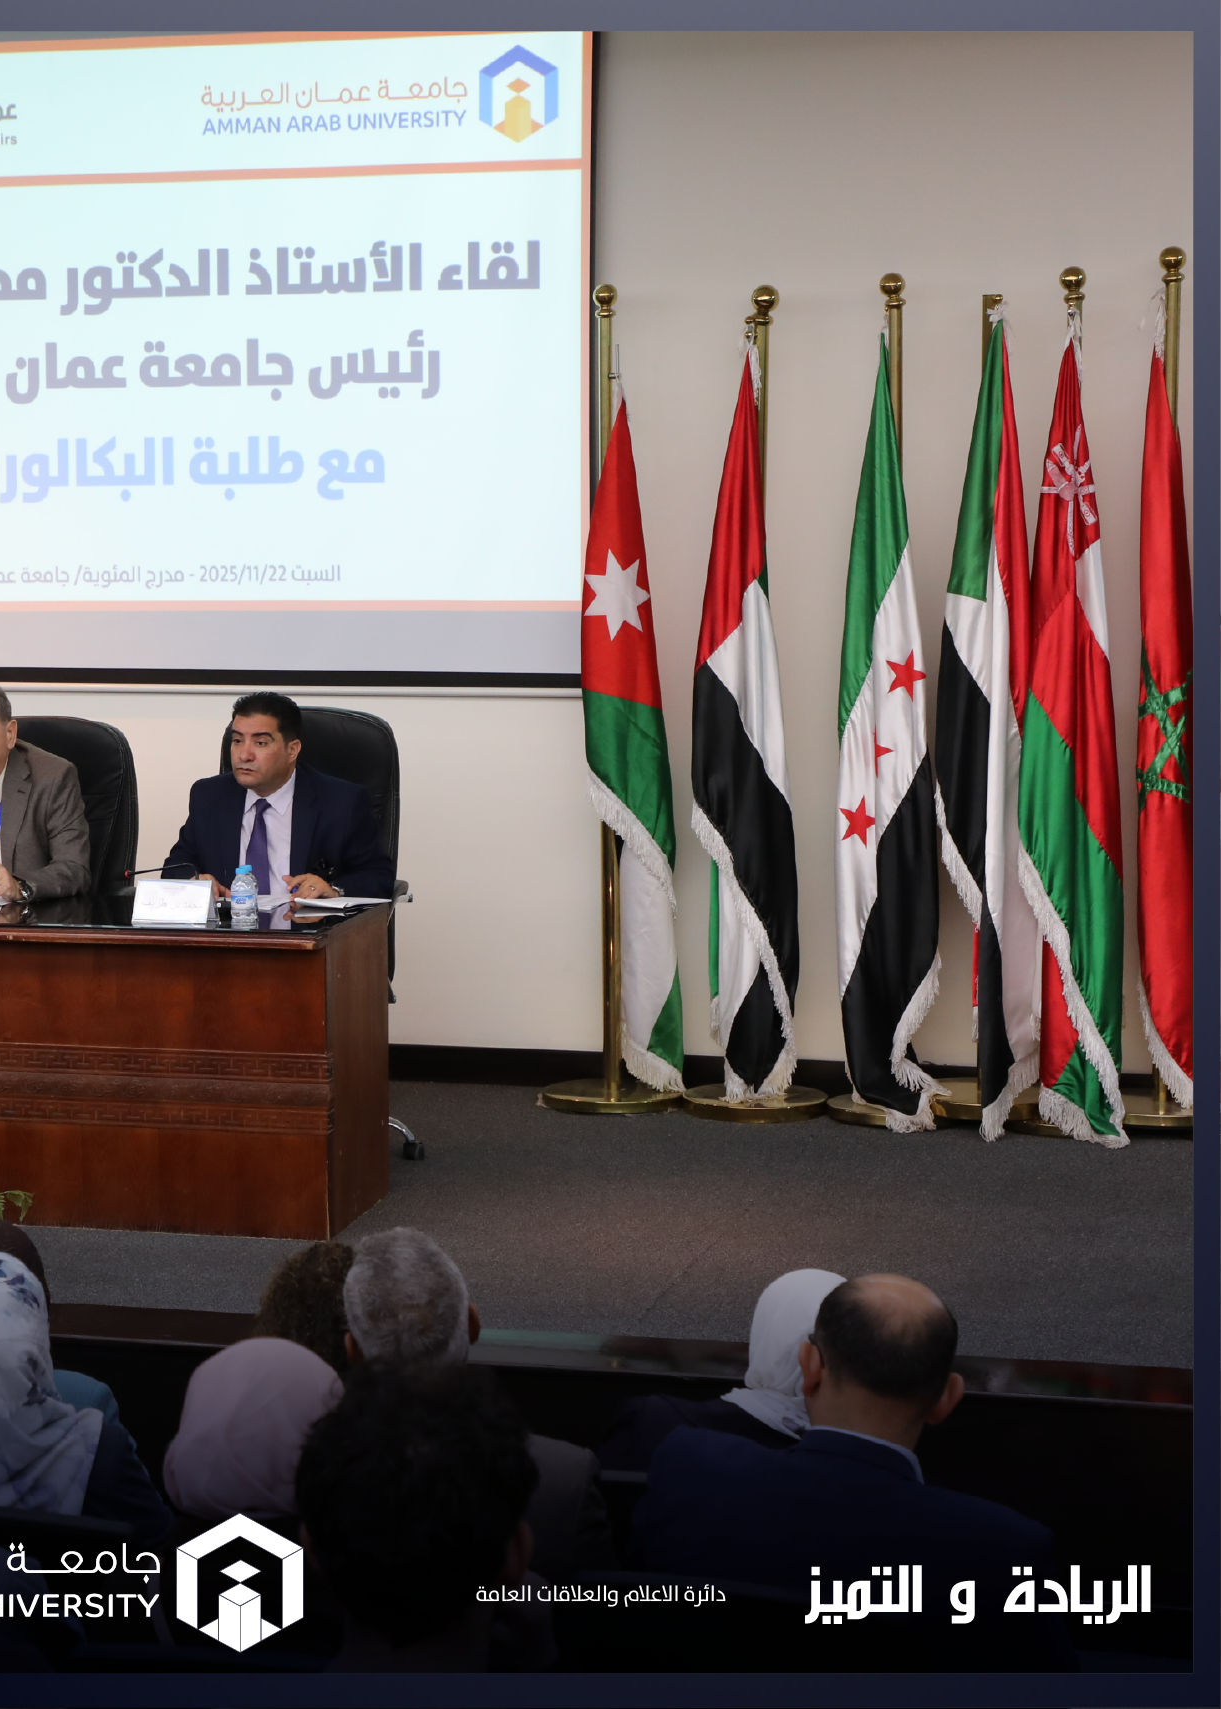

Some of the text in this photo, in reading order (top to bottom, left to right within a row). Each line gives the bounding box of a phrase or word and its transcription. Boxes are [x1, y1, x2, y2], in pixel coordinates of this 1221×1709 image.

[201, 77, 467, 112] جامعة عمان العربية
[203, 110, 466, 135] AMMAN ARAB UNIVERSITY
[60, 248, 229, 315] الدكتور
[246, 240, 422, 295] الأستاذ
[438, 240, 540, 290] لقاء
[6, 342, 127, 404] عمان
[139, 338, 294, 401] جامعة
[308, 329, 440, 399] رئيس
[189, 436, 304, 500] طلبة
[317, 449, 385, 500] مع
[21, 566, 70, 586] جامعة
[145, 570, 184, 589] مدرج
[200, 564, 286, 585] 2025/11/22
[292, 565, 340, 585] السبت
